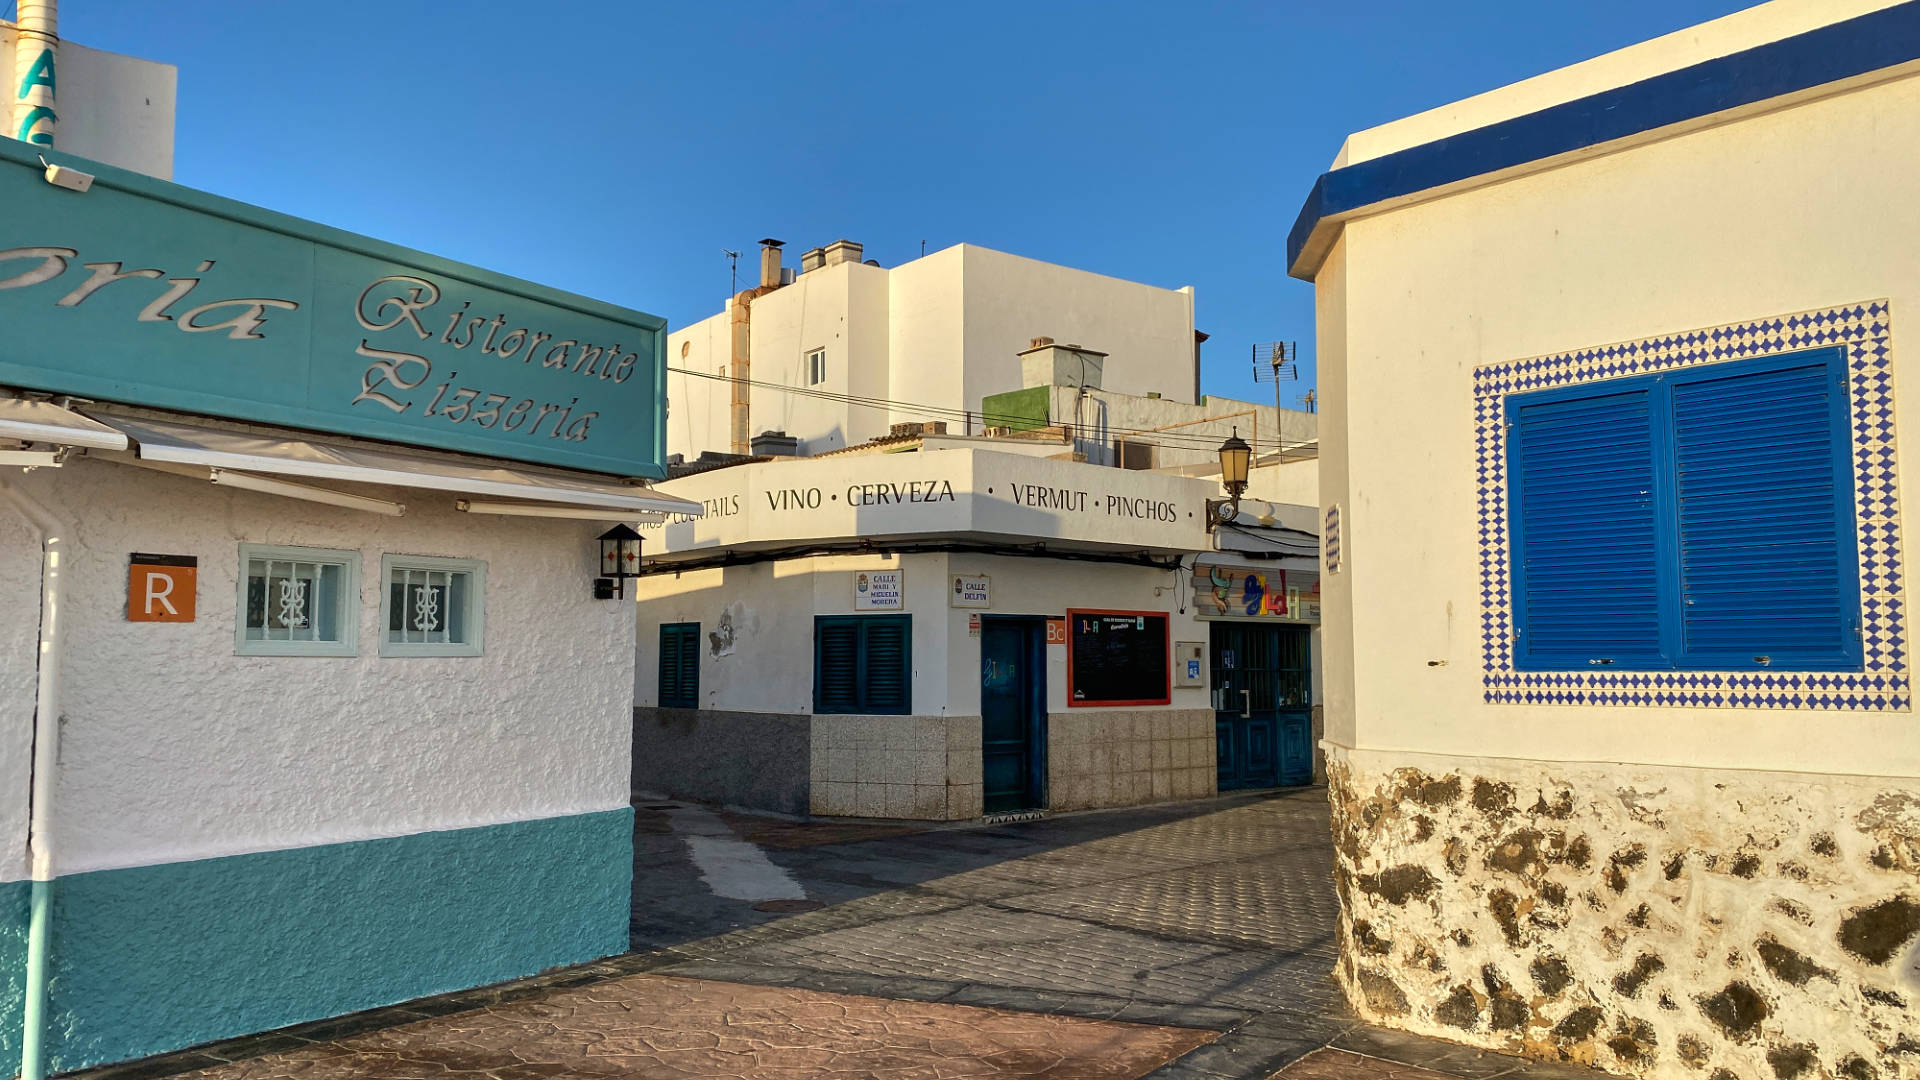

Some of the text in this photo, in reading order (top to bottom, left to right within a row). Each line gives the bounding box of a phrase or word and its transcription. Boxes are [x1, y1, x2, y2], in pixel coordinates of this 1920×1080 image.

[355, 275, 638, 384] Ristorante
[352, 339, 599, 442] Pizzeria
[766, 480, 956, 511] VINO CERVEZA
[1010, 483, 1177, 523] VERMUT PINCHOS
[145, 572, 178, 615] R
[873, 575, 896, 583] CALLE
[965, 583, 986, 591] CALLE
[1048, 623, 1065, 641] Bc
